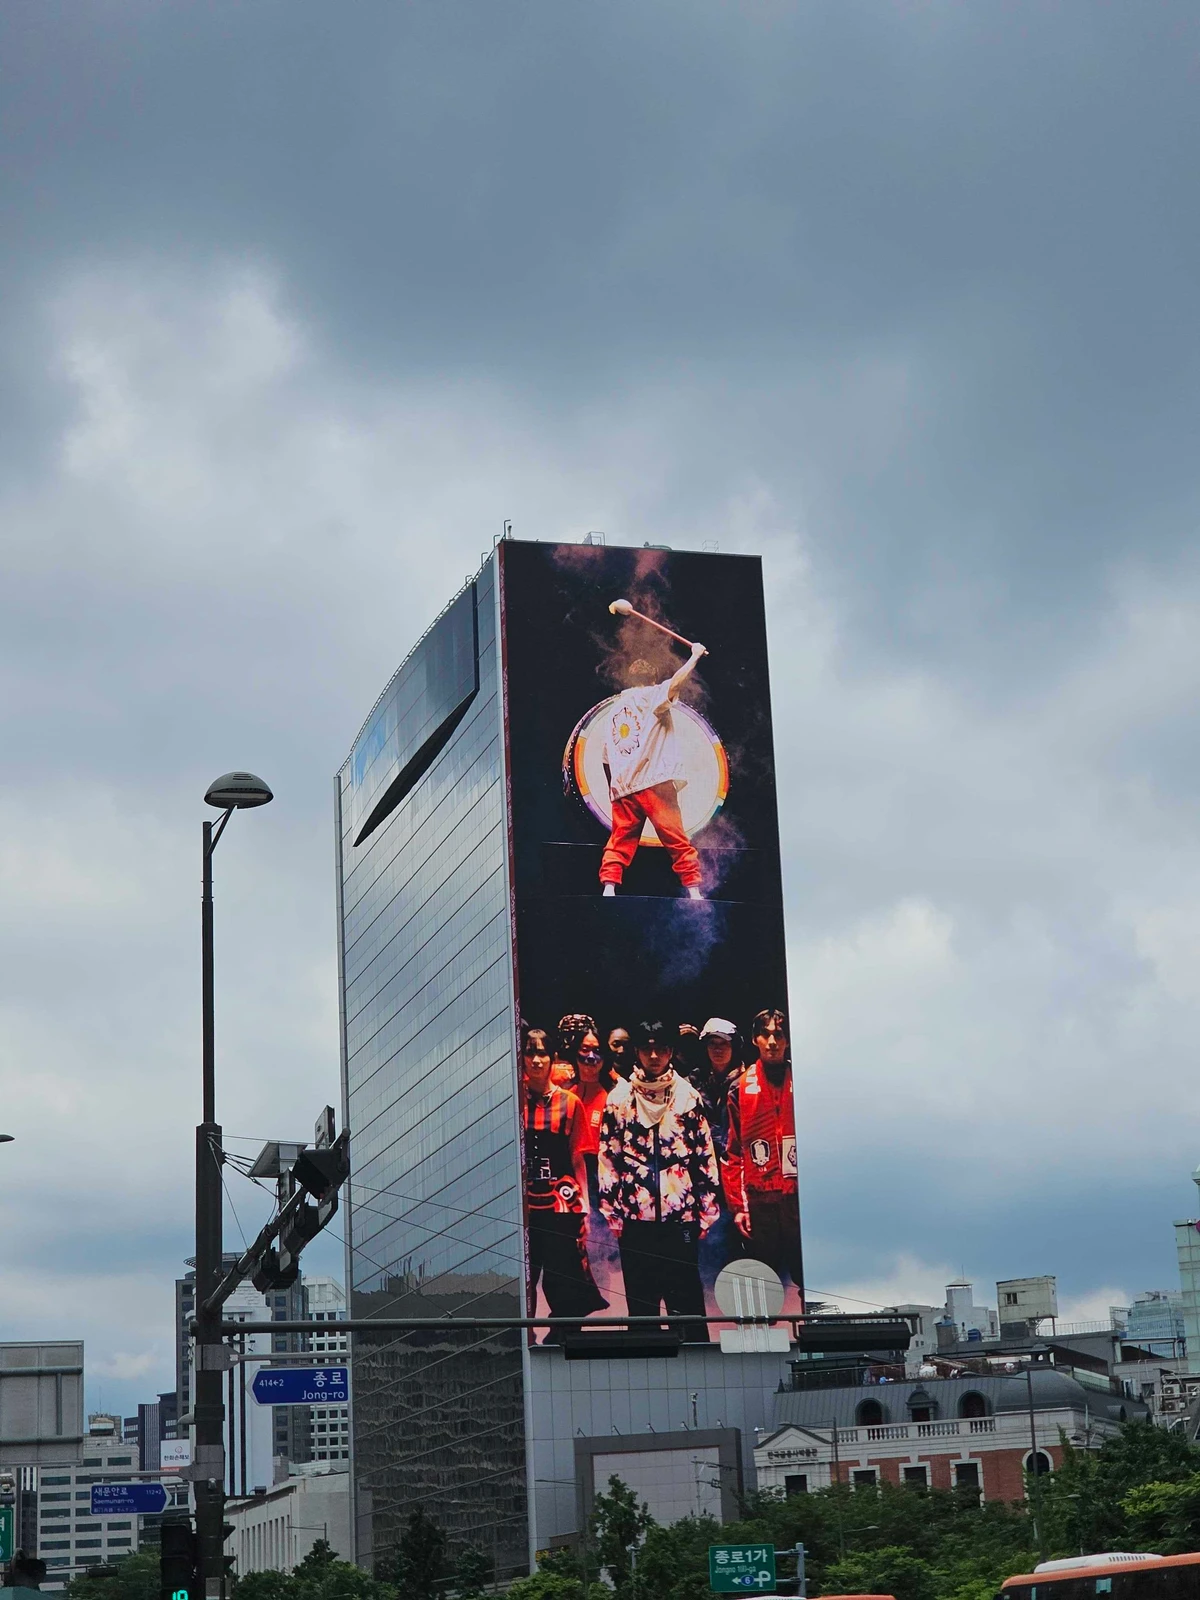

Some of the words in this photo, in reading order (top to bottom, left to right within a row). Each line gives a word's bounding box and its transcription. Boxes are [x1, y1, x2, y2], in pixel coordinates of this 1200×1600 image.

[313, 1371, 345, 1388] 종로
[301, 1390, 345, 1402] Jong-ro
[94, 1486, 129, 1497] 새문안로
[714, 1548, 768, 1565] 종로1가
[744, 1576, 751, 1585] 6
